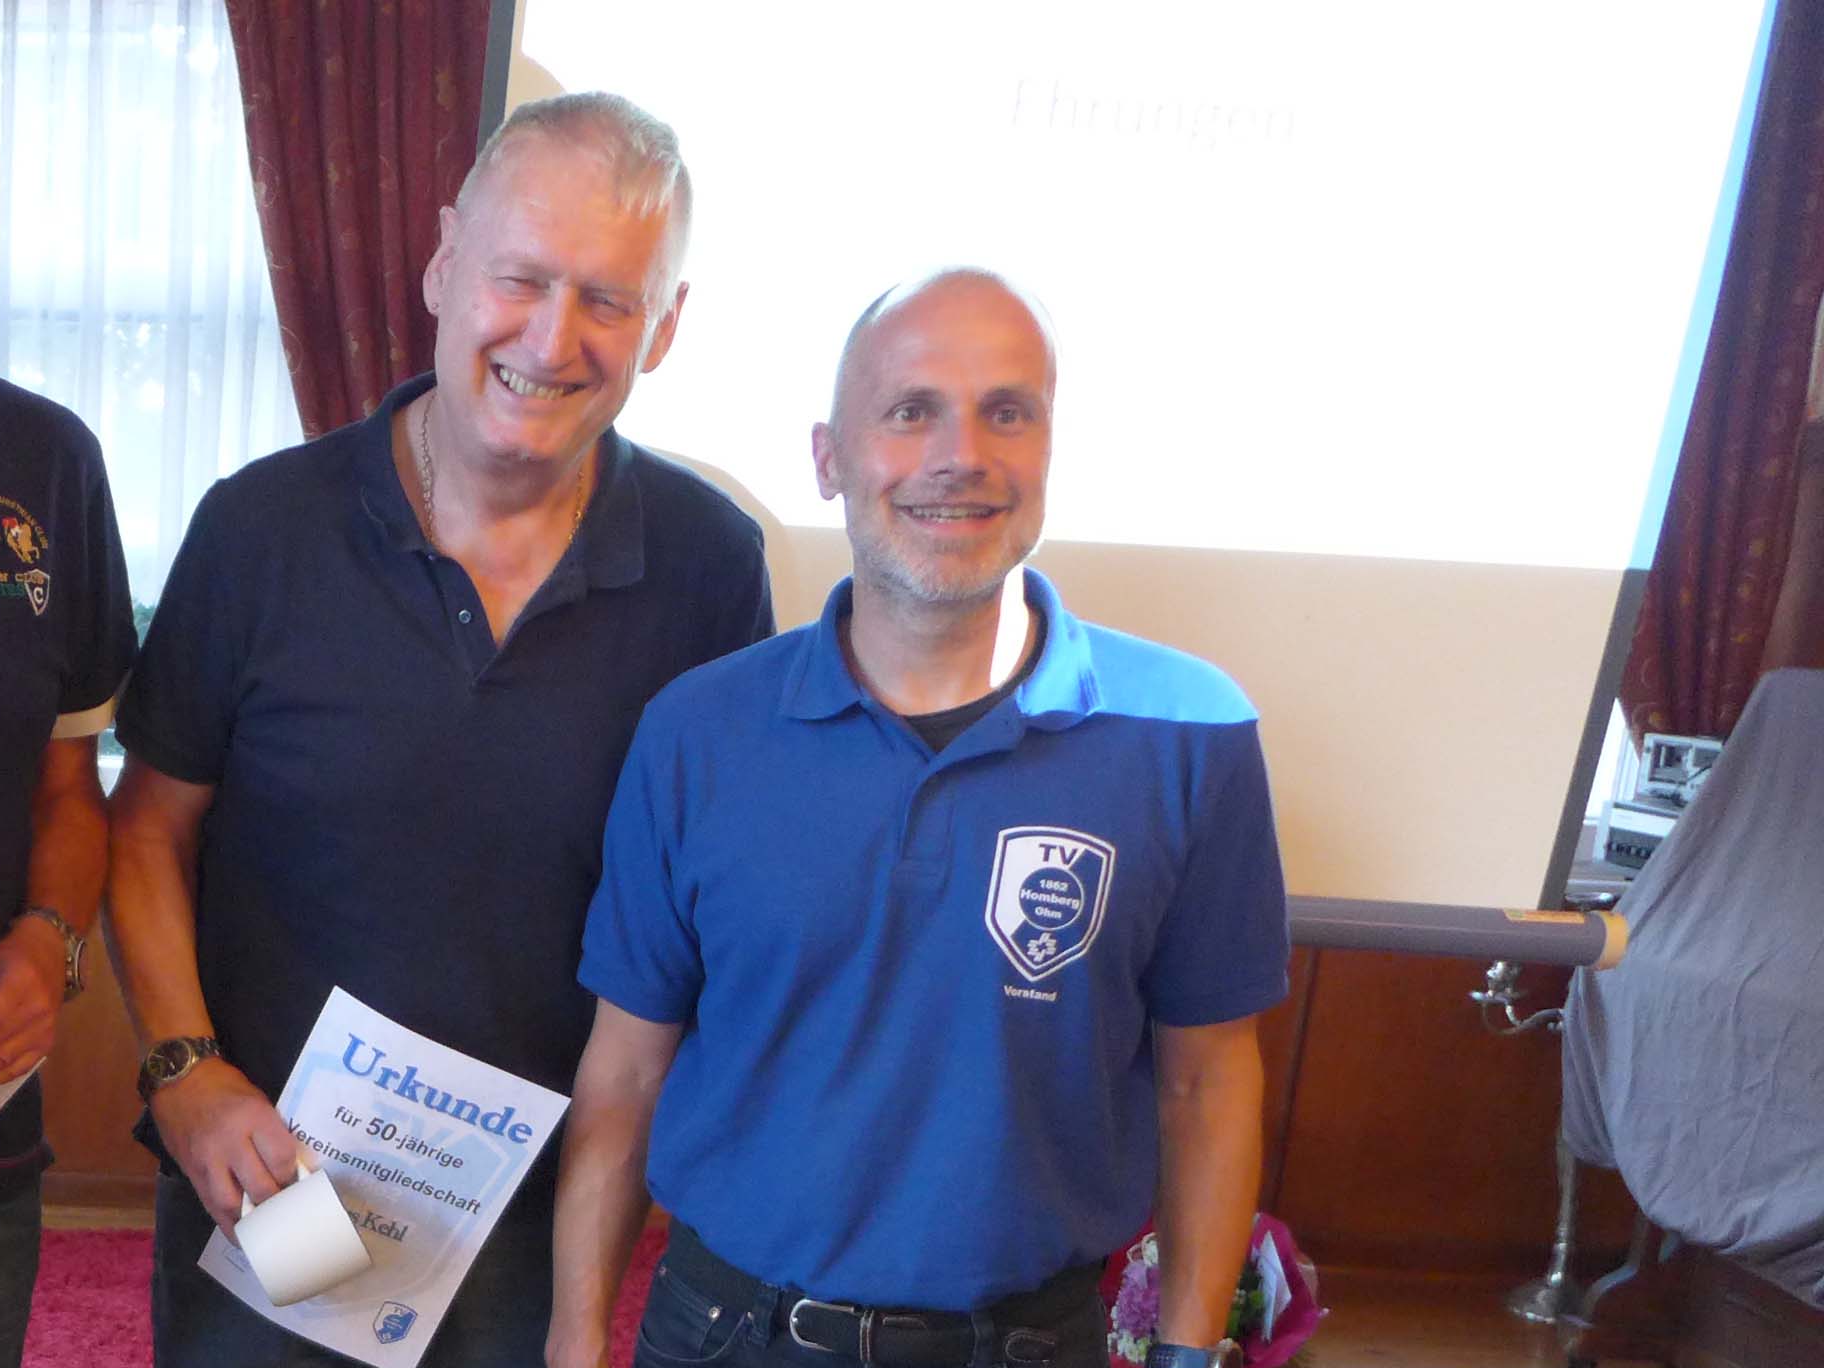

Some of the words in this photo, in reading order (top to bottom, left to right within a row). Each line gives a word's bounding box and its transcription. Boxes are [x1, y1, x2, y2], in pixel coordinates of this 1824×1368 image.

[1039, 843, 1078, 866] TV
[1039, 878, 1069, 892] 1862
[1020, 888, 1080, 910] Homberg
[1034, 905, 1062, 919] Ohm
[1003, 984, 1057, 1001] Vorstand
[342, 1032, 533, 1144] Urkunde
[334, 1105, 362, 1128] für
[366, 1117, 464, 1169] 50-jährige
[287, 1118, 481, 1215] Vereinsmitgliedschaft
